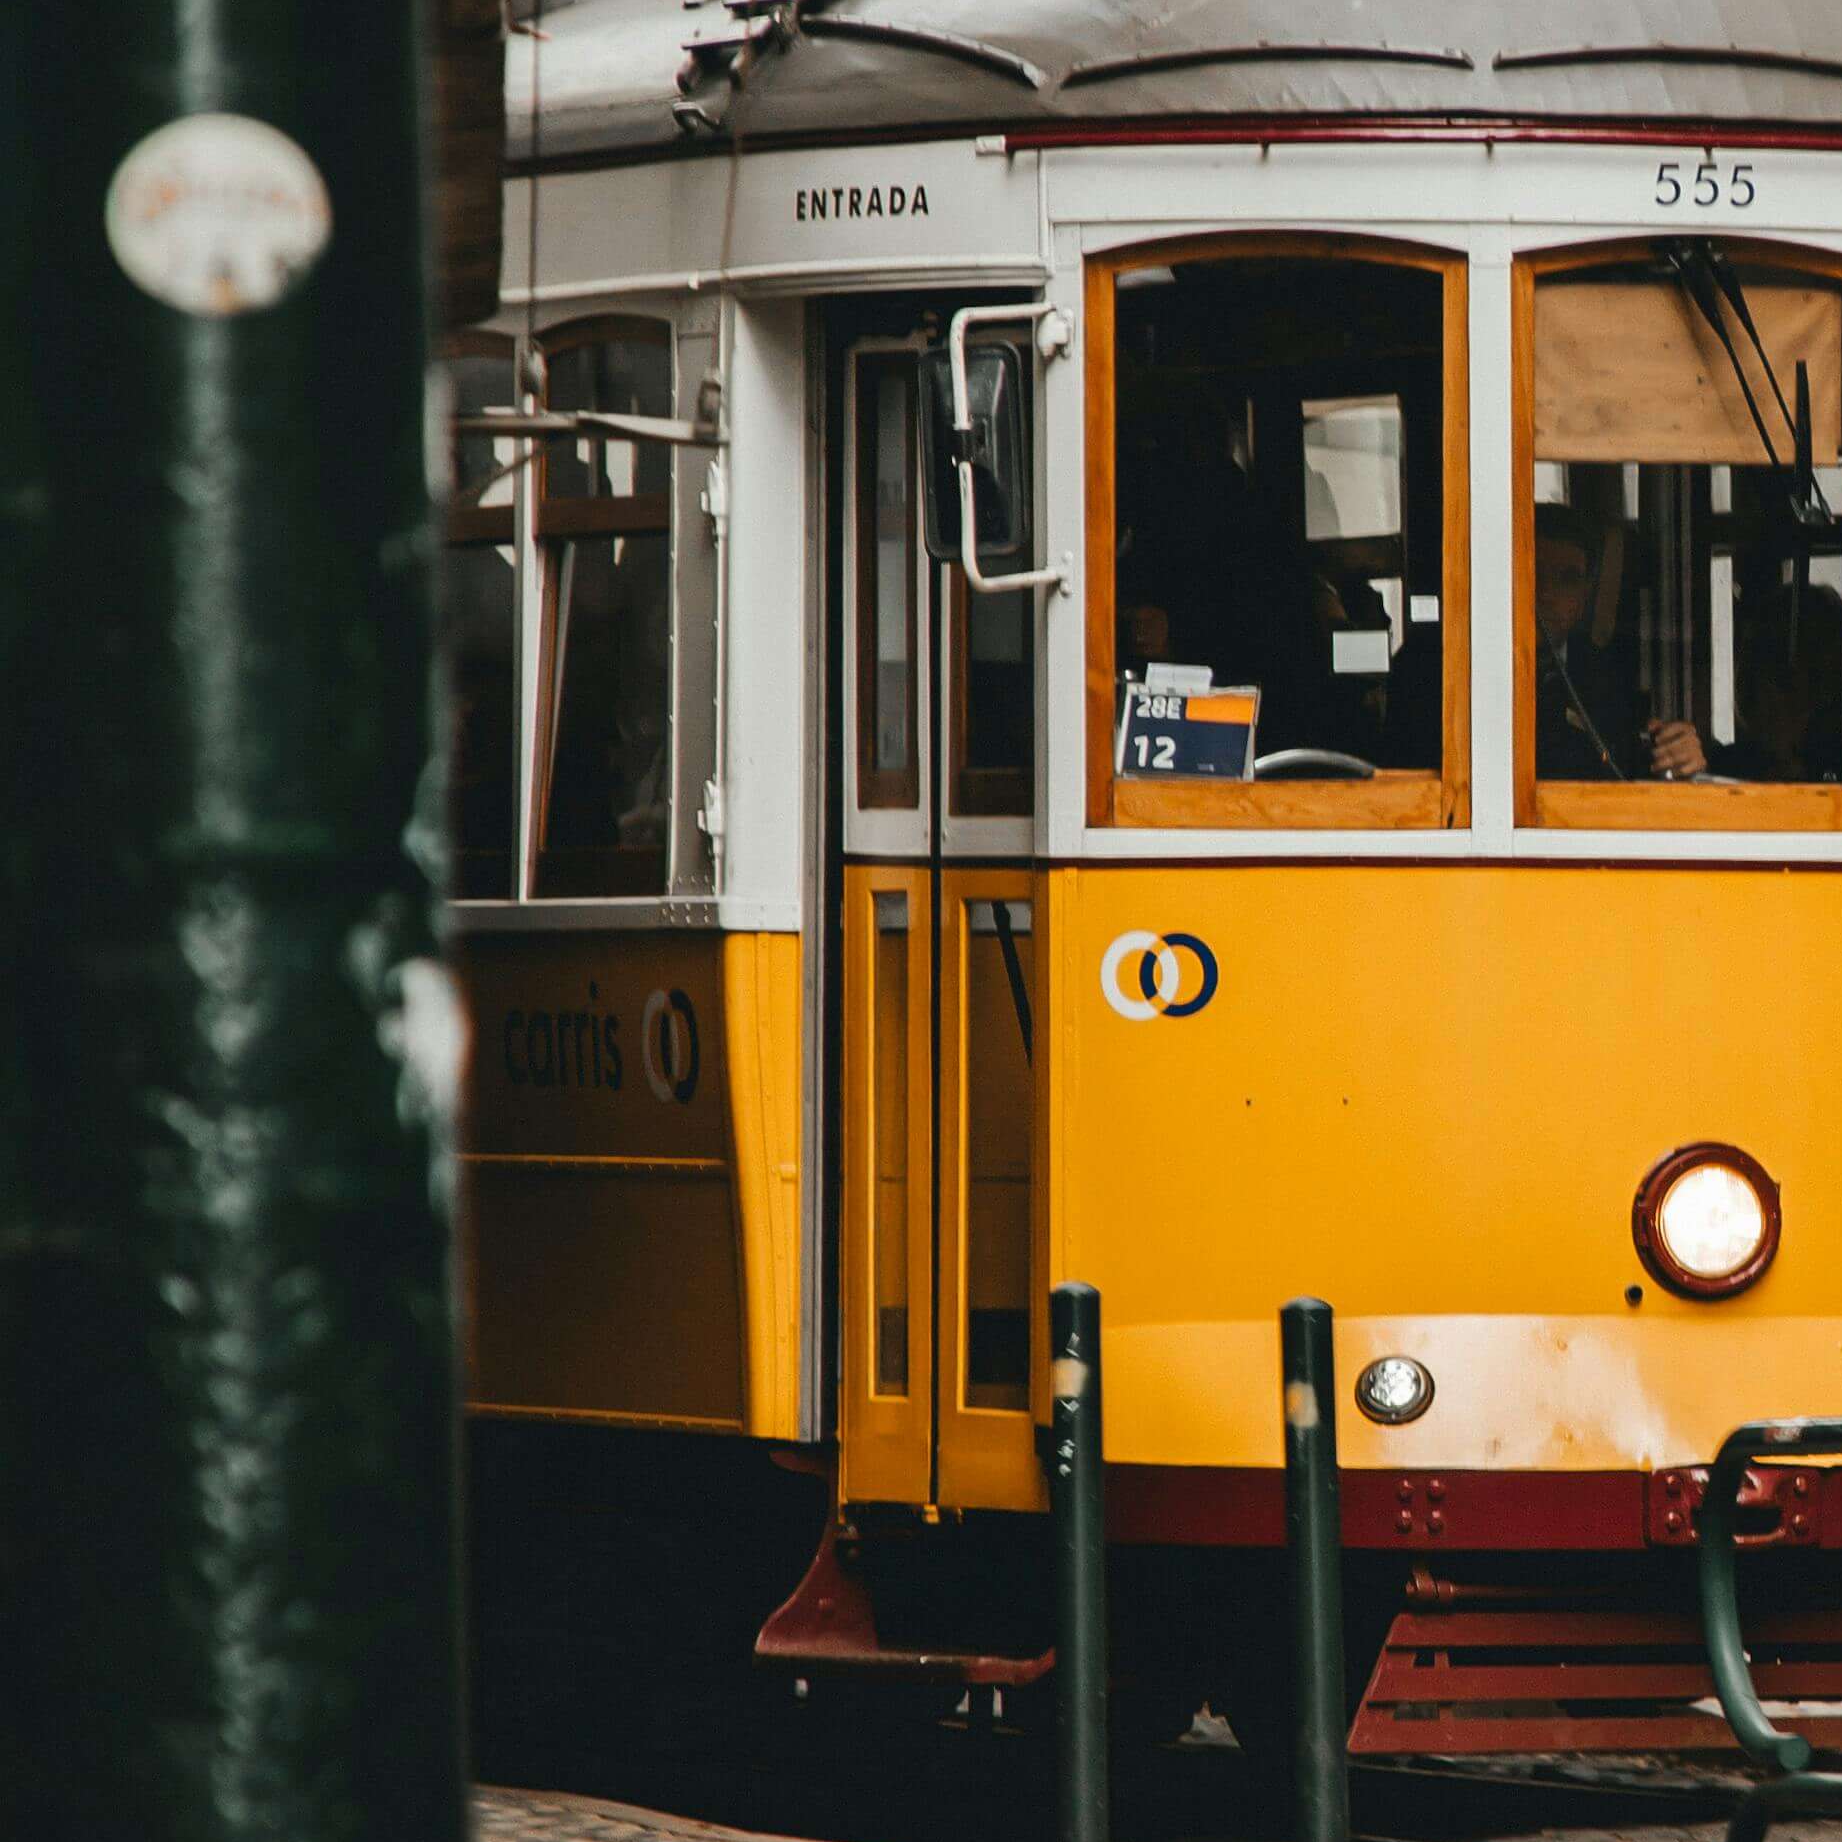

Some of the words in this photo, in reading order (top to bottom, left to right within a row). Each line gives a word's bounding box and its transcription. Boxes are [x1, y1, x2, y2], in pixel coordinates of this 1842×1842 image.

[1655, 163, 1756, 207] 555
[795, 185, 929, 222] ENTRADA
[1136, 695, 1182, 720] 28E
[1134, 735, 1177, 769] 12
